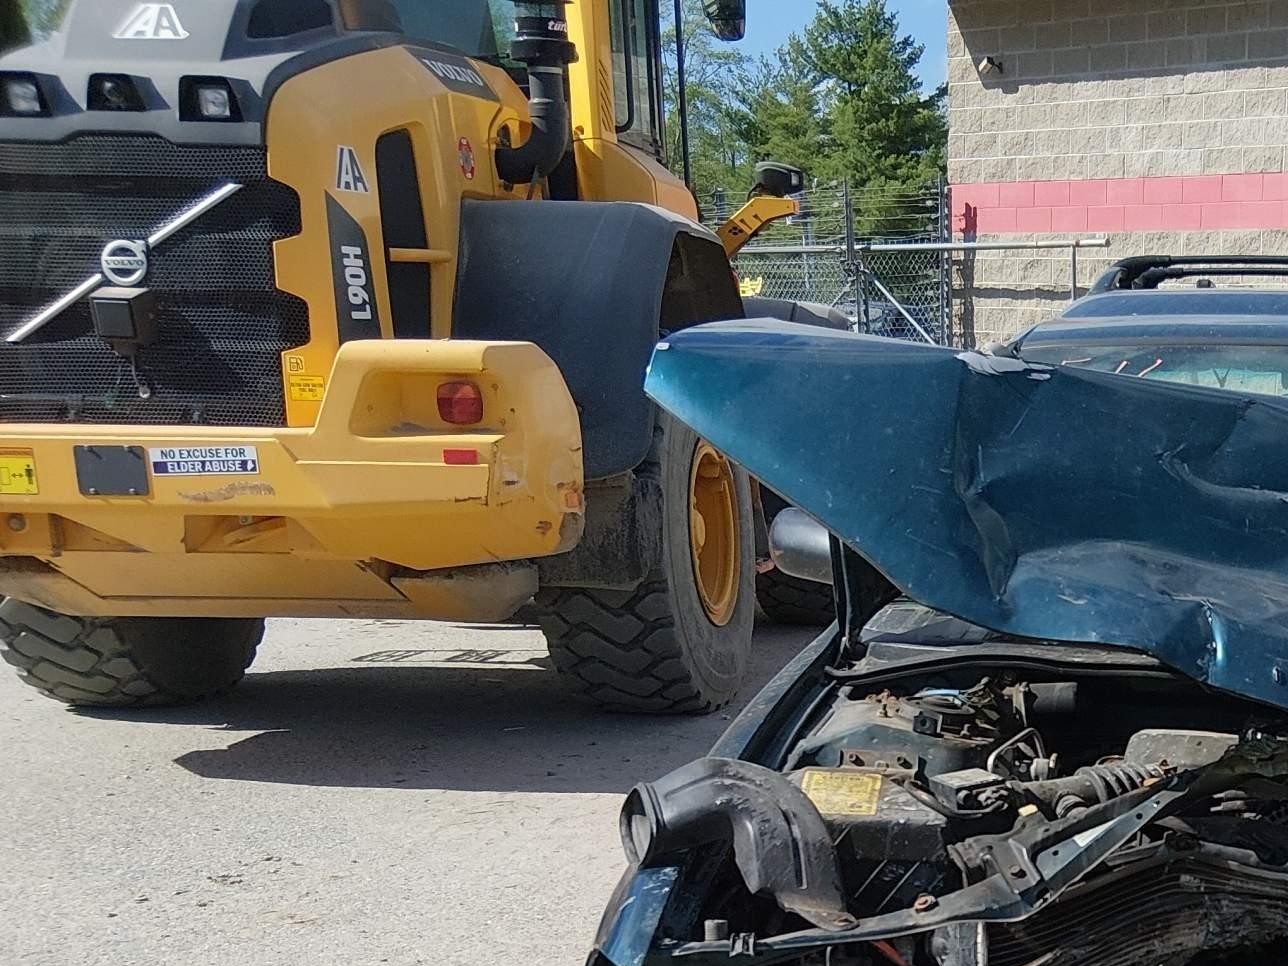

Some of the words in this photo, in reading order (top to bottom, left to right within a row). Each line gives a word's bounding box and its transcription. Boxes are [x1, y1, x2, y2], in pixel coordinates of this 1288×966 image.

[421, 58, 484, 87] VOLVO
[341, 245, 372, 320] L90H
[160, 449, 176, 460] NO
[179, 448, 222, 459] EXCUSE
[224, 447, 247, 458] FOR
[167, 461, 204, 473] ELDER
[204, 460, 243, 472] ABUSE
